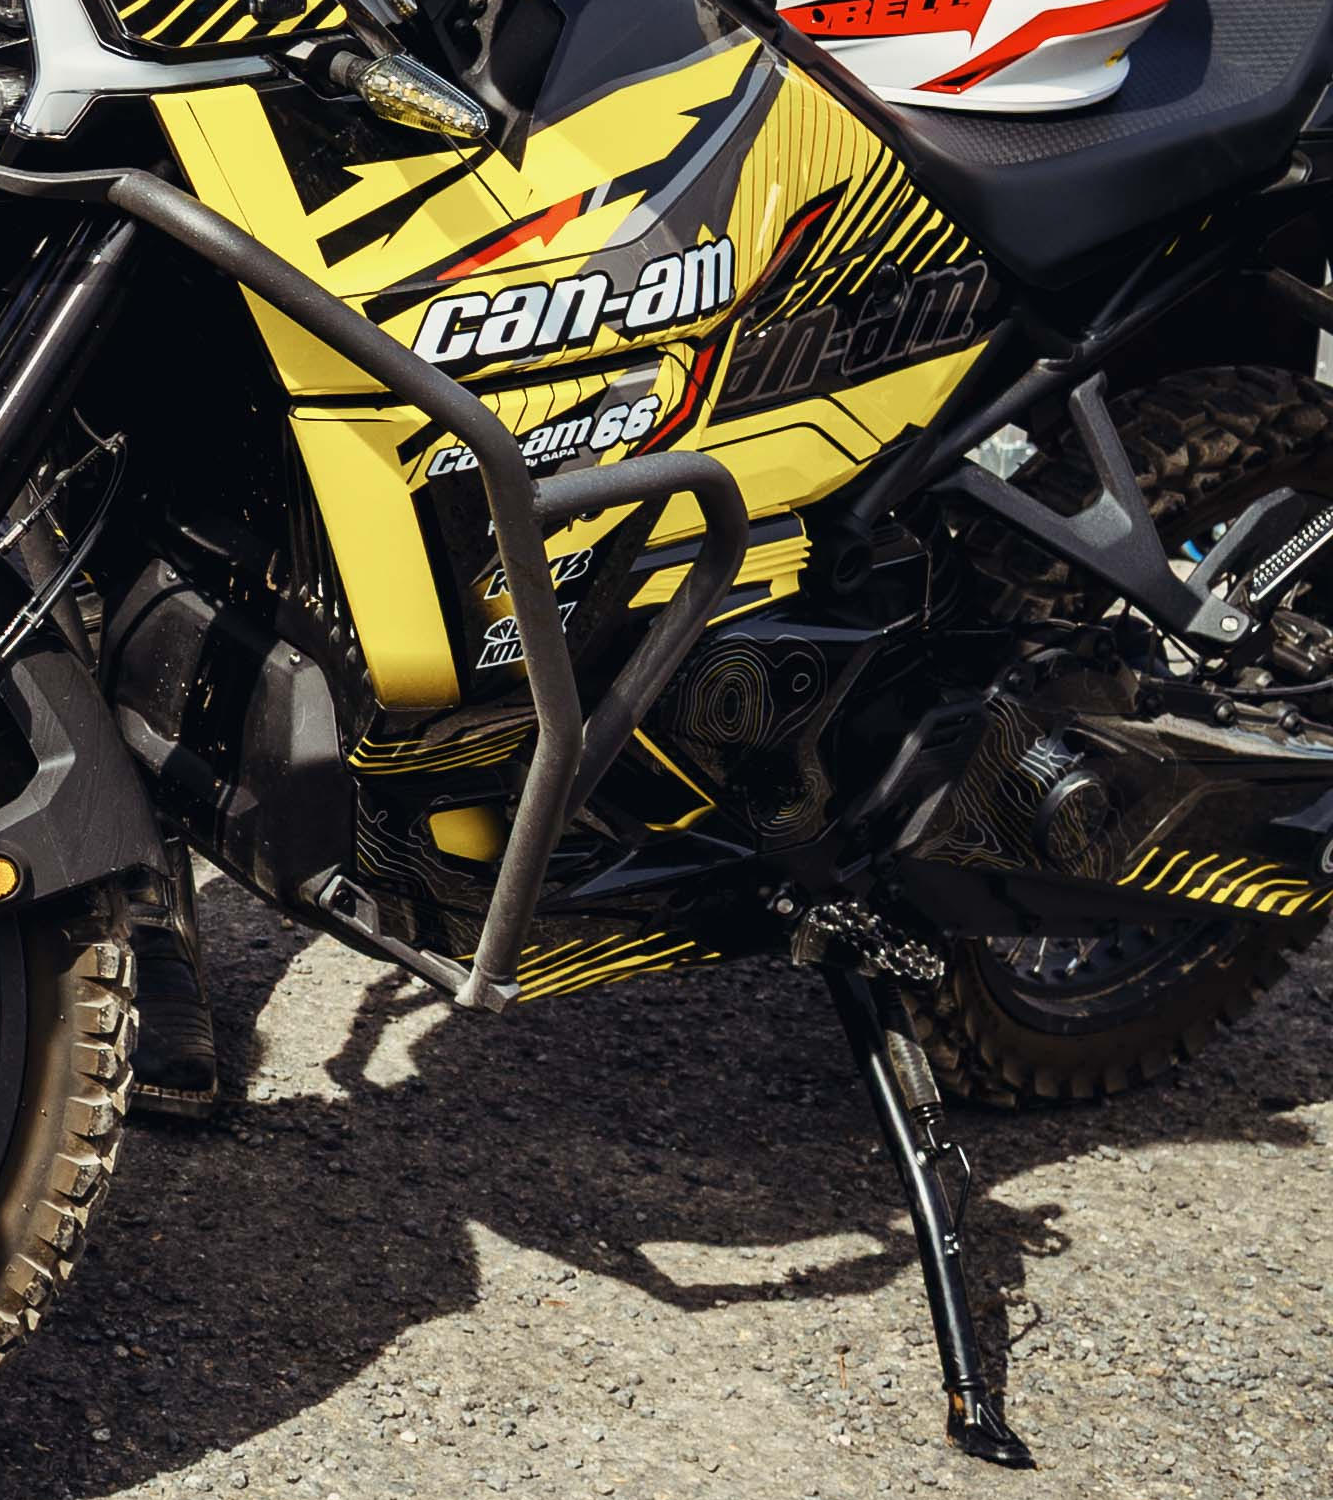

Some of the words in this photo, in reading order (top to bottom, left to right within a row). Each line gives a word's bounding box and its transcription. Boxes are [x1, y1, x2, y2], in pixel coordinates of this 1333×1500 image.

[412, 236, 735, 363] can-am
[590, 393, 662, 450] 66
[540, 447, 576, 464] GAPA
